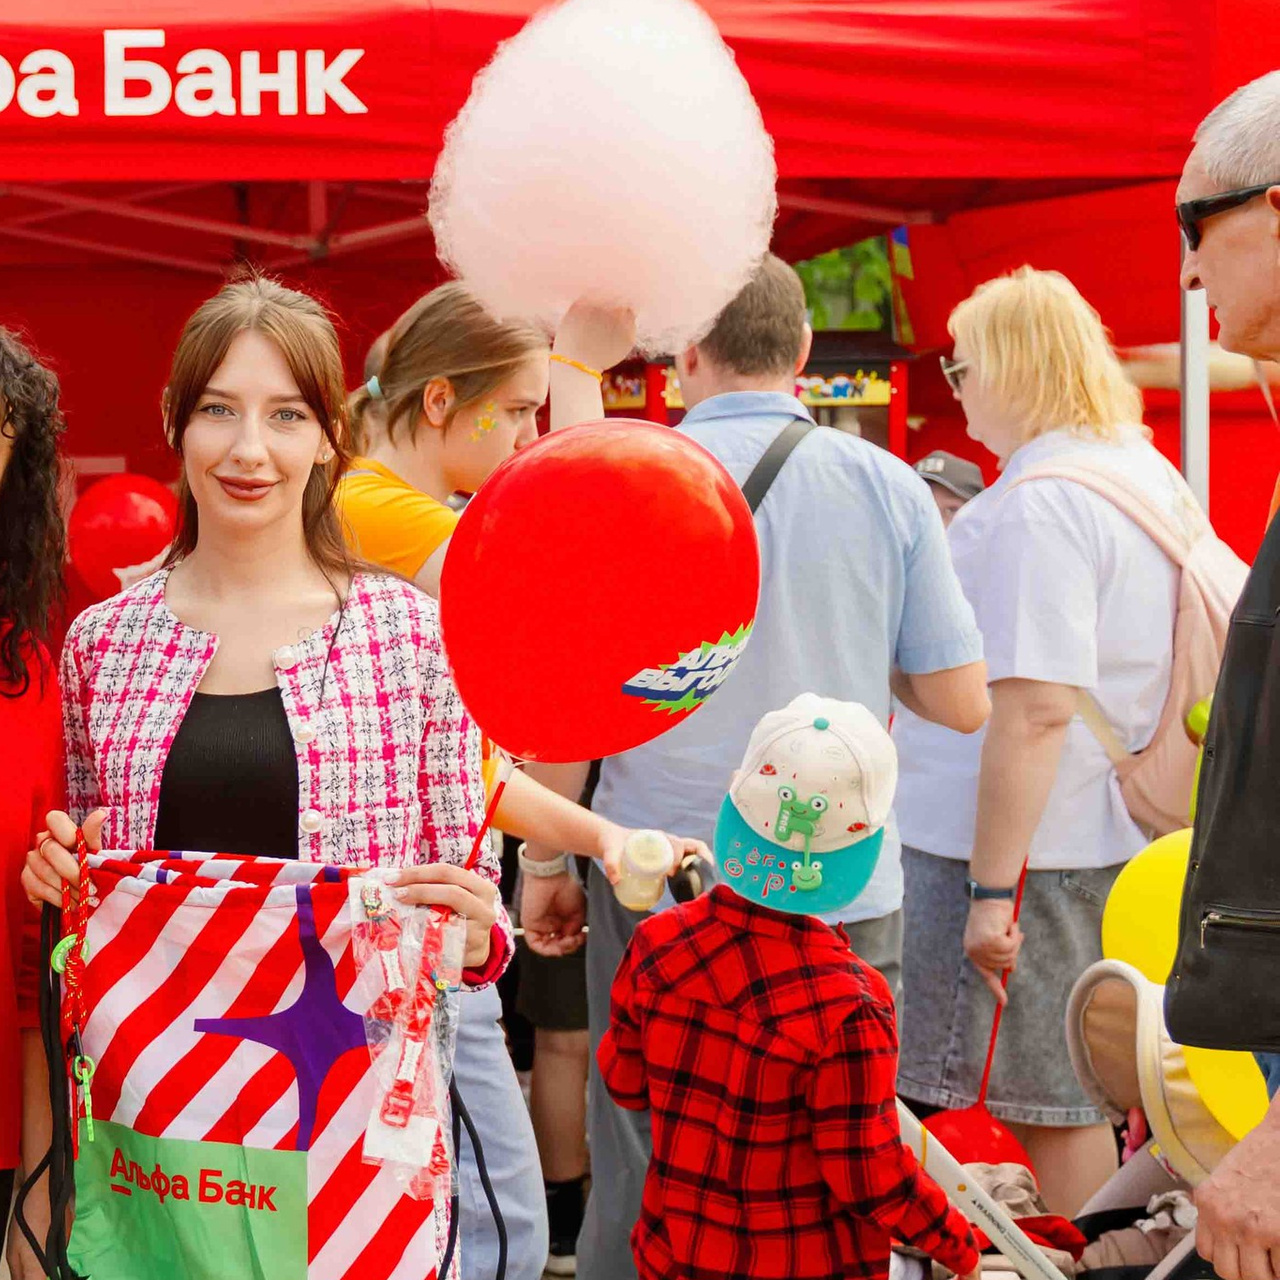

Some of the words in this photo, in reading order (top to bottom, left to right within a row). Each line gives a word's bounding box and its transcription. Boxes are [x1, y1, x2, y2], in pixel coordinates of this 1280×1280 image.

[103, 28, 369, 117] Банк
[623, 658, 737, 692] ВЫГО
[666, 634, 749, 670] АЛЬ
[109, 1147, 190, 1204] Альфа
[198, 1168, 278, 1212] Банк
